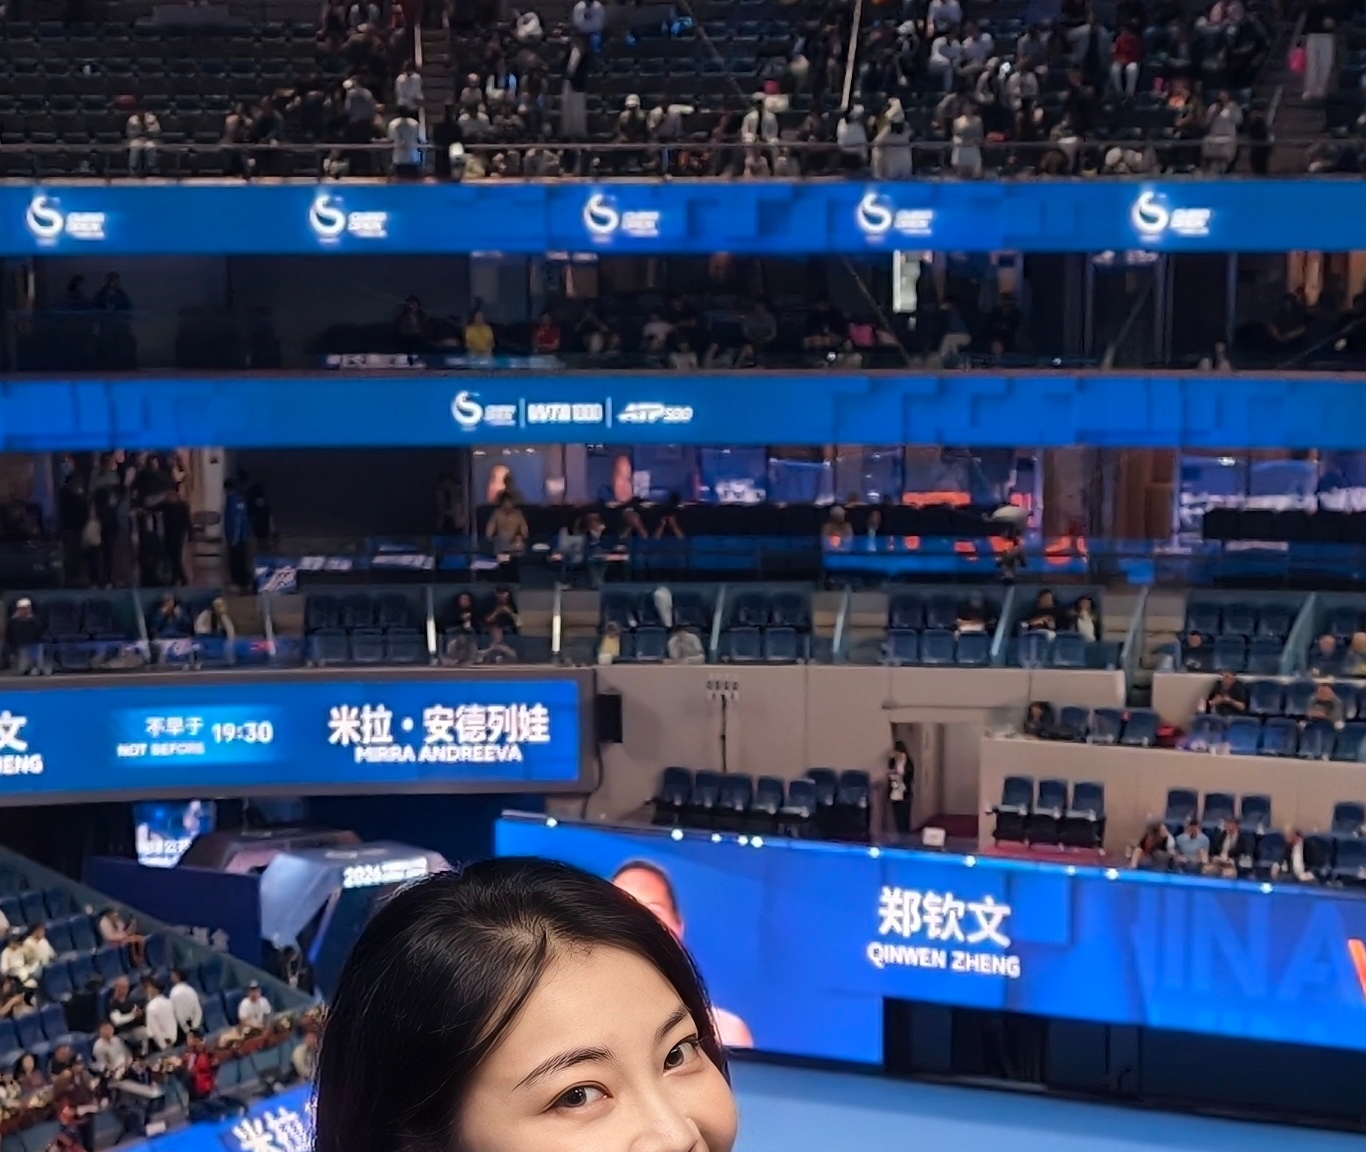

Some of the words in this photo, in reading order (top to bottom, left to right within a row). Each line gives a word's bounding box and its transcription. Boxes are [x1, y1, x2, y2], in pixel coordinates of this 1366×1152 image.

[146, 716, 203, 736] 不早于
[212, 721, 274, 744] 19:30
[354, 745, 416, 763] MIRRA
[418, 745, 523, 763] ANDREEVA
[878, 886, 1011, 947] 郑钦文
[866, 941, 947, 969] QINWEN
[951, 950, 1021, 978] ZHENG
